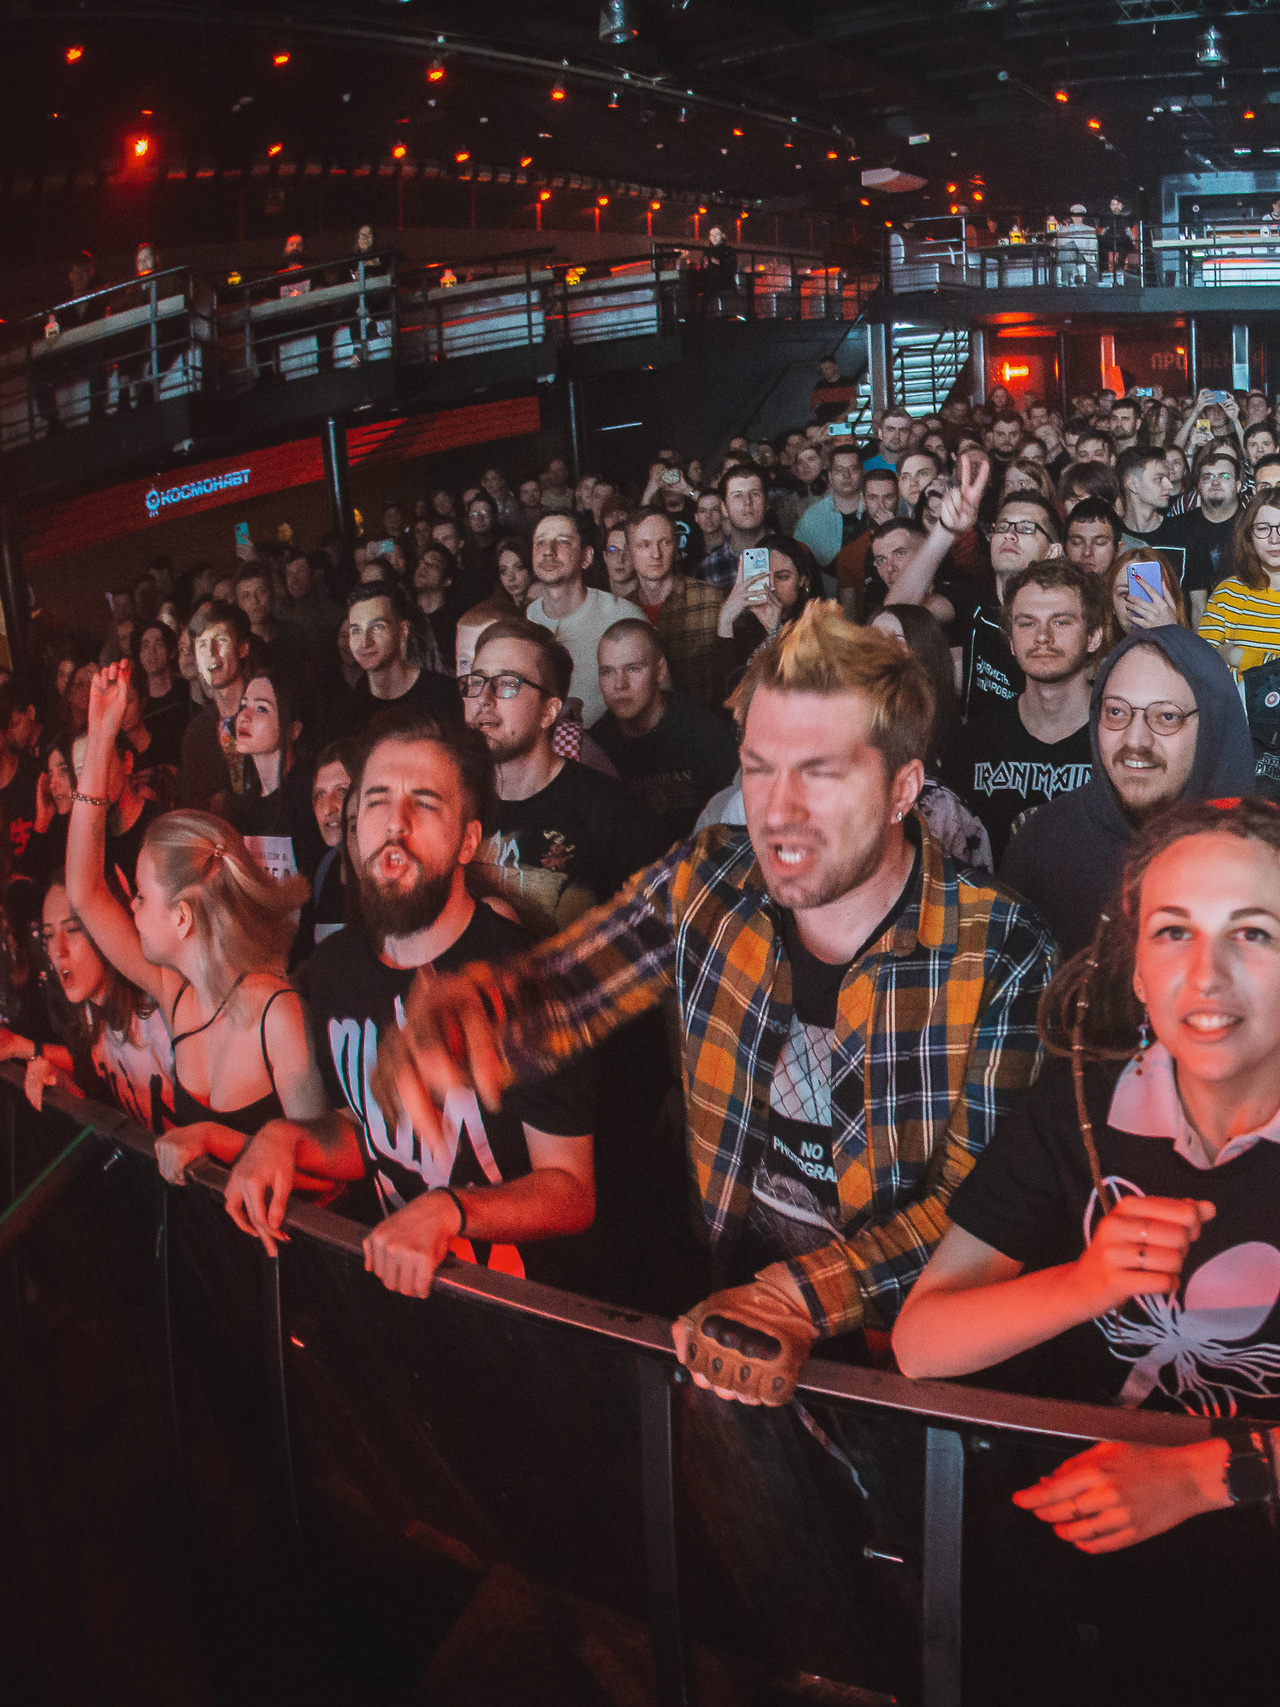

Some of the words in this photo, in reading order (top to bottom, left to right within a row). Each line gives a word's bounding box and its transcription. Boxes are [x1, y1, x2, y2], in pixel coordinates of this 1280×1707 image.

[161, 469, 251, 506] КОСМОНАВТ
[974, 761, 1031, 799] IRON
[801, 1141, 824, 1160] NO
